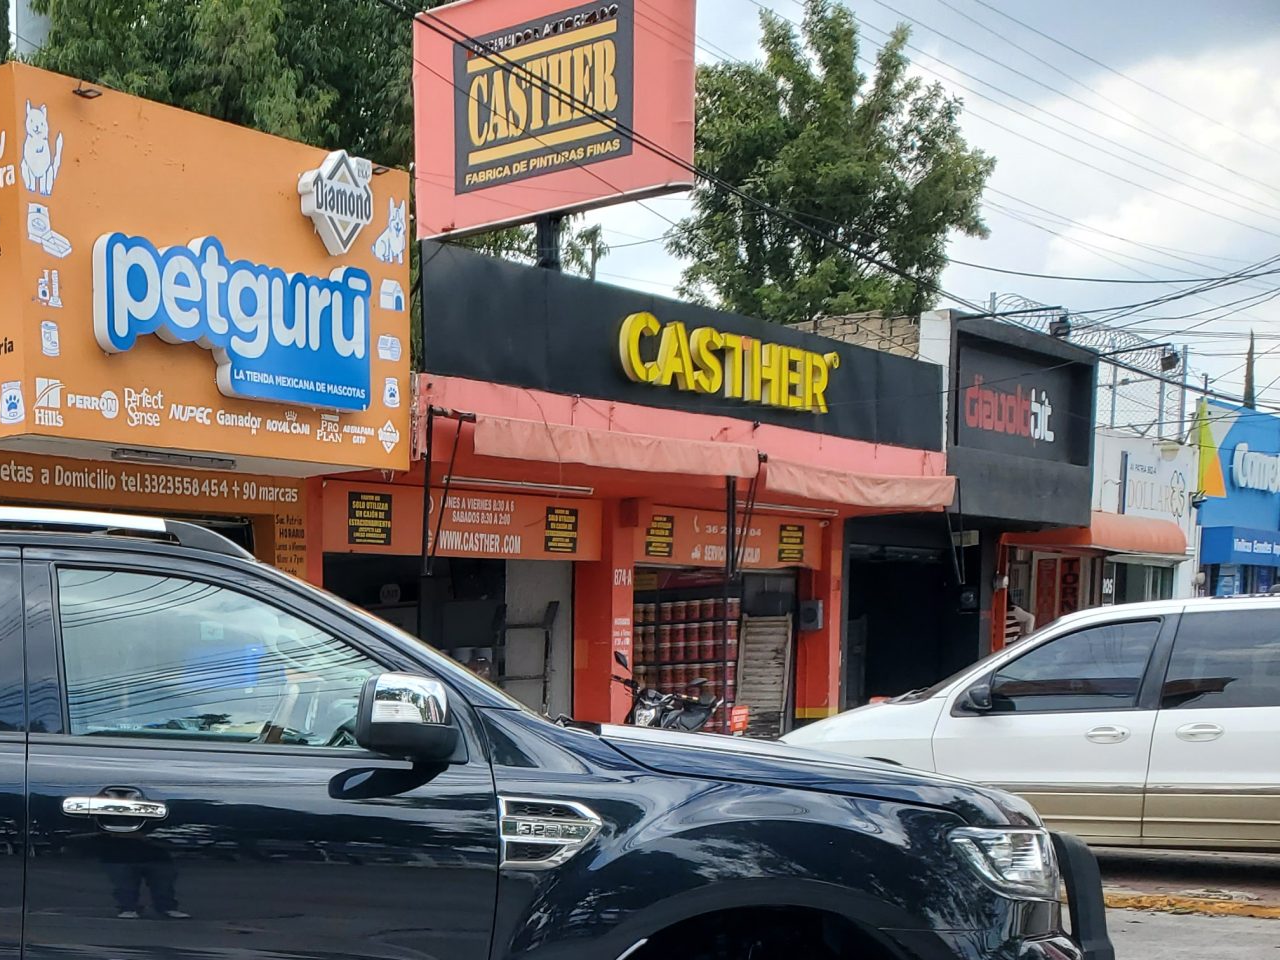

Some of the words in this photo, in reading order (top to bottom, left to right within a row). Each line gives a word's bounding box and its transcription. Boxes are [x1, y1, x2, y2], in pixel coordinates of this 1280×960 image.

[468, 39, 618, 146] CASTHER
[465, 163, 511, 186] FABRICA
[512, 159, 528, 176] DE
[529, 147, 585, 171] PINTURAS
[586, 138, 621, 159] FINAS
[313, 172, 372, 222] Diamond
[234, 368, 246, 380] LA
[245, 370, 275, 385] TIENDA
[275, 375, 316, 391] MEXICANA
[316, 380, 327, 393] DE
[326, 382, 366, 399] MASCOTAS
[124, 387, 164, 410] Perfect
[35, 408, 64, 427] Hill's
[127, 404, 161, 427] Sense
[169, 403, 213, 425] NUPEC
[216, 409, 262, 429] Ganador
[317, 430, 342, 443] PLAN
[321, 420, 339, 432] PRO
[41, 466, 50, 485] a
[55, 465, 116, 490] Domicilio
[243, 486, 257, 501] 90
[258, 485, 299, 503] marcas
[704, 544, 728, 562] SERVICI
[521, 823, 545, 836] 3.2
